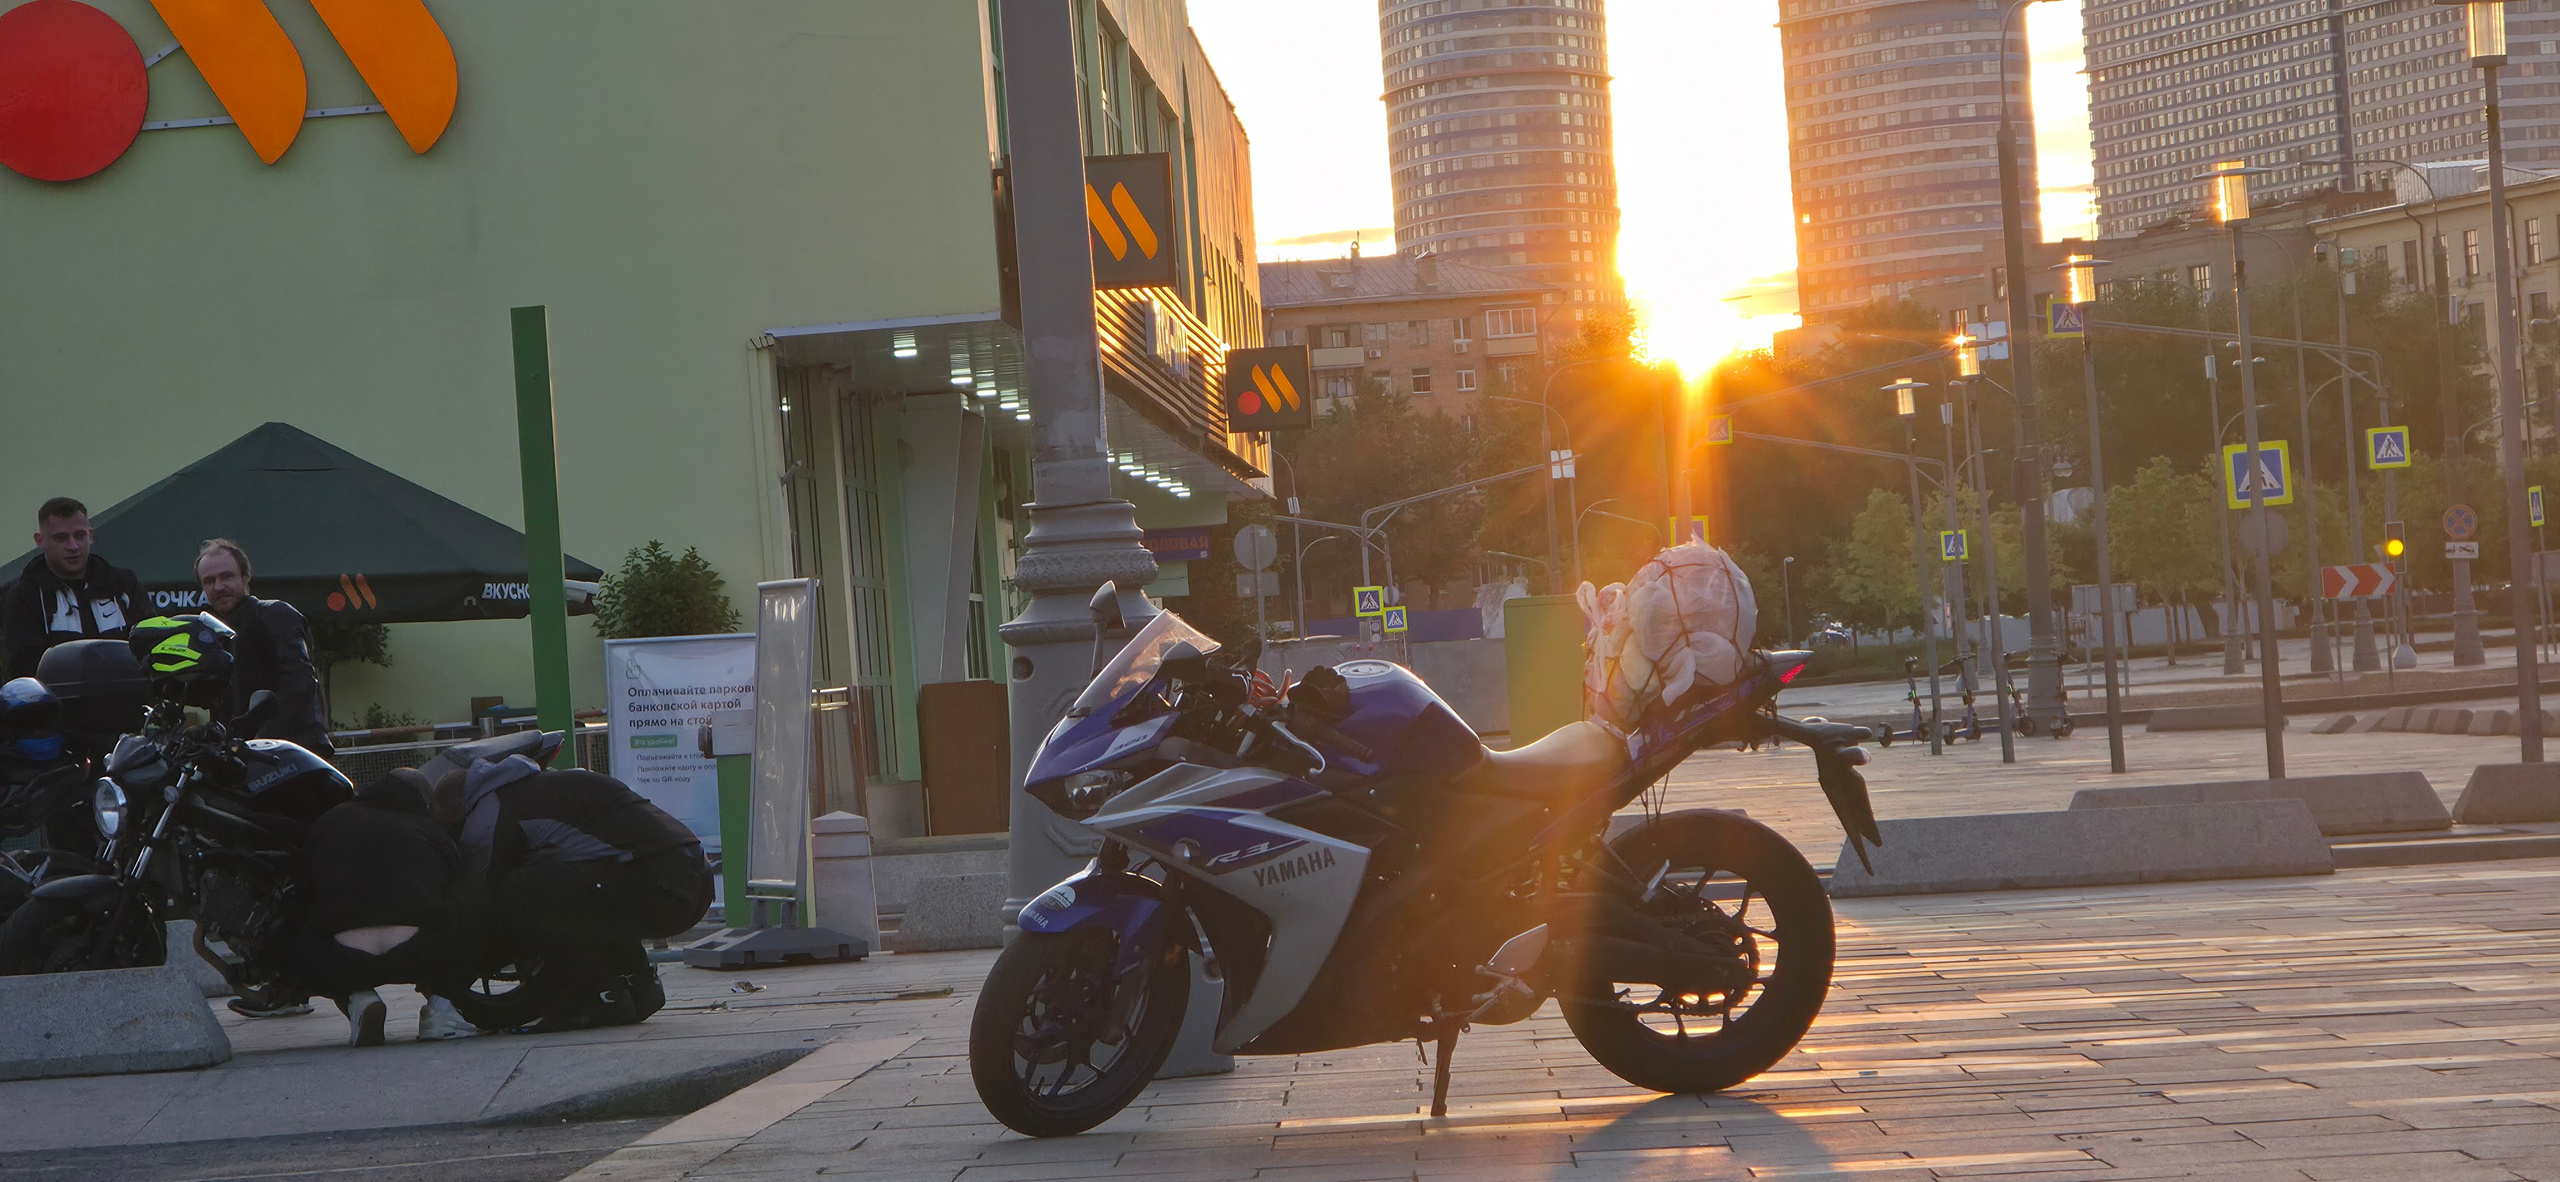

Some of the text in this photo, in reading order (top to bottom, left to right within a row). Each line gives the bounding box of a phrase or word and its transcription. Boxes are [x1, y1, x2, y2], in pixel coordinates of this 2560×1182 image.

[627, 684, 706, 697] Оплачивайте
[628, 698, 741, 712] банковской картой
[629, 718, 667, 729] прямо
[670, 718, 684, 727] на
[247, 763, 298, 792] SUZUKI
[1205, 841, 1270, 868] R3
[1252, 846, 1337, 888] YAMAHA
